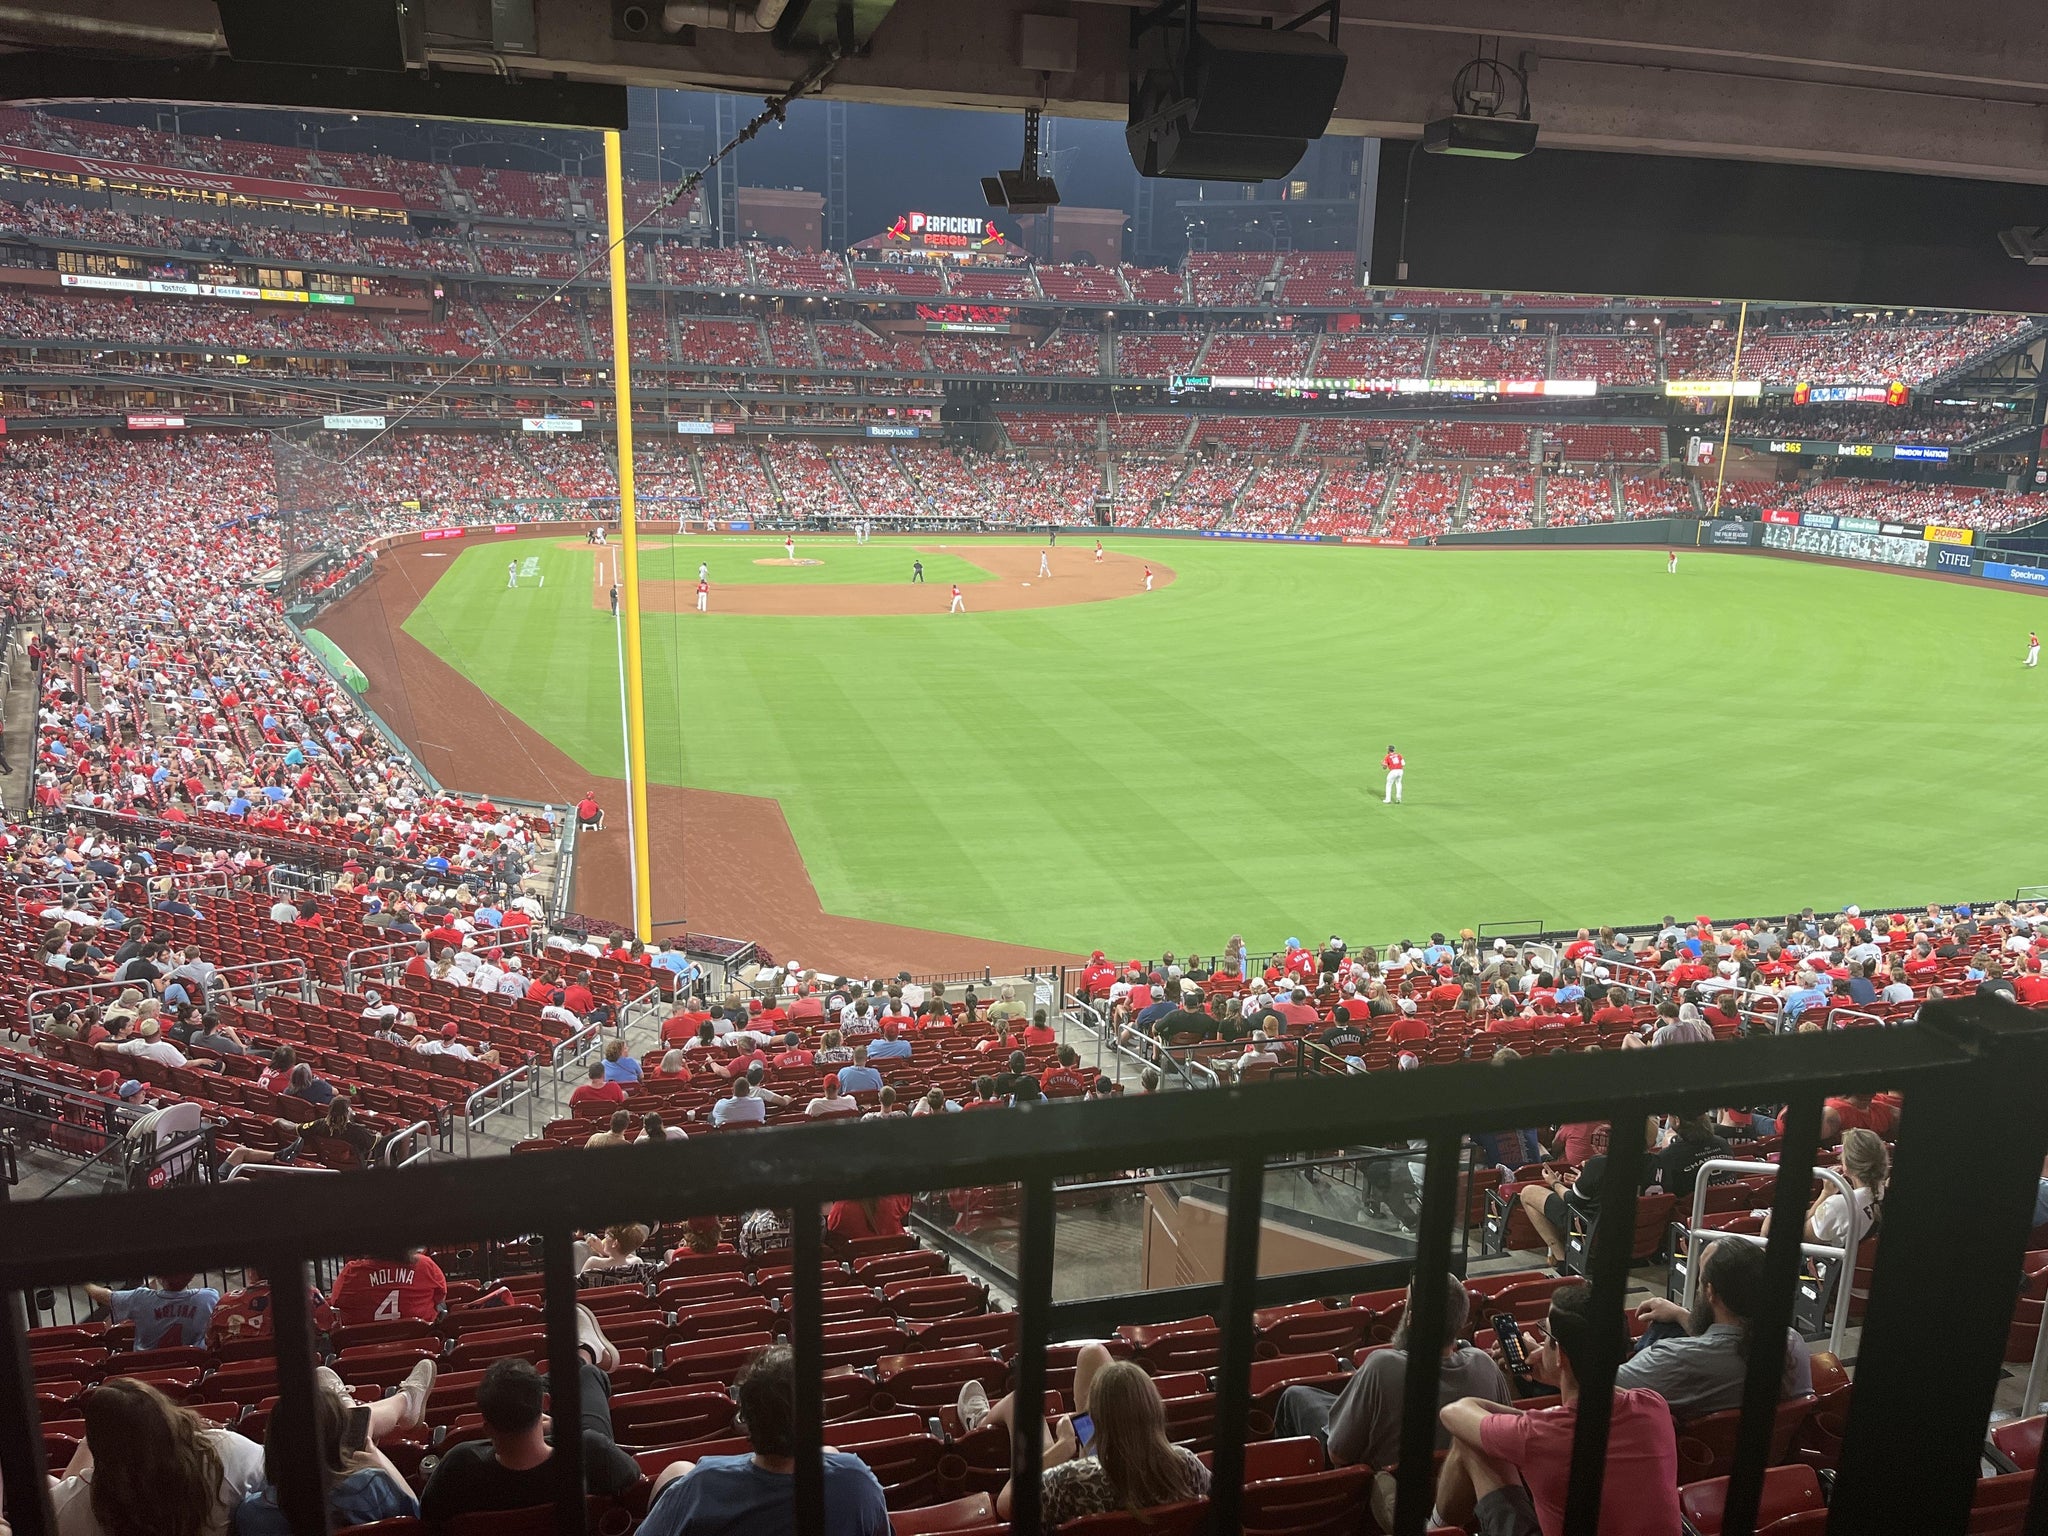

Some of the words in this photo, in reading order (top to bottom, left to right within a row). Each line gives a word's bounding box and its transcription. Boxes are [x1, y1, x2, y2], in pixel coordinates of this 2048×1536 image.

[77, 161, 233, 190] Budweiser
[909, 212, 982, 234] PERFICIENT
[924, 233, 968, 246] PERCH
[1770, 442, 1802, 453] bet365
[1838, 444, 1872, 456] bet365
[1923, 449, 1949, 459] NATION
[1934, 528, 1963, 539] DOBBS
[1938, 550, 1971, 568] STIFEL
[2010, 568, 2044, 582] Spectrum
[1100, 968, 1115, 976] LOUIS
[1303, 959, 1312, 973] 4
[150, 1171, 164, 1185] 130
[369, 1268, 415, 1287] MOLINA
[374, 1289, 401, 1321] 4
